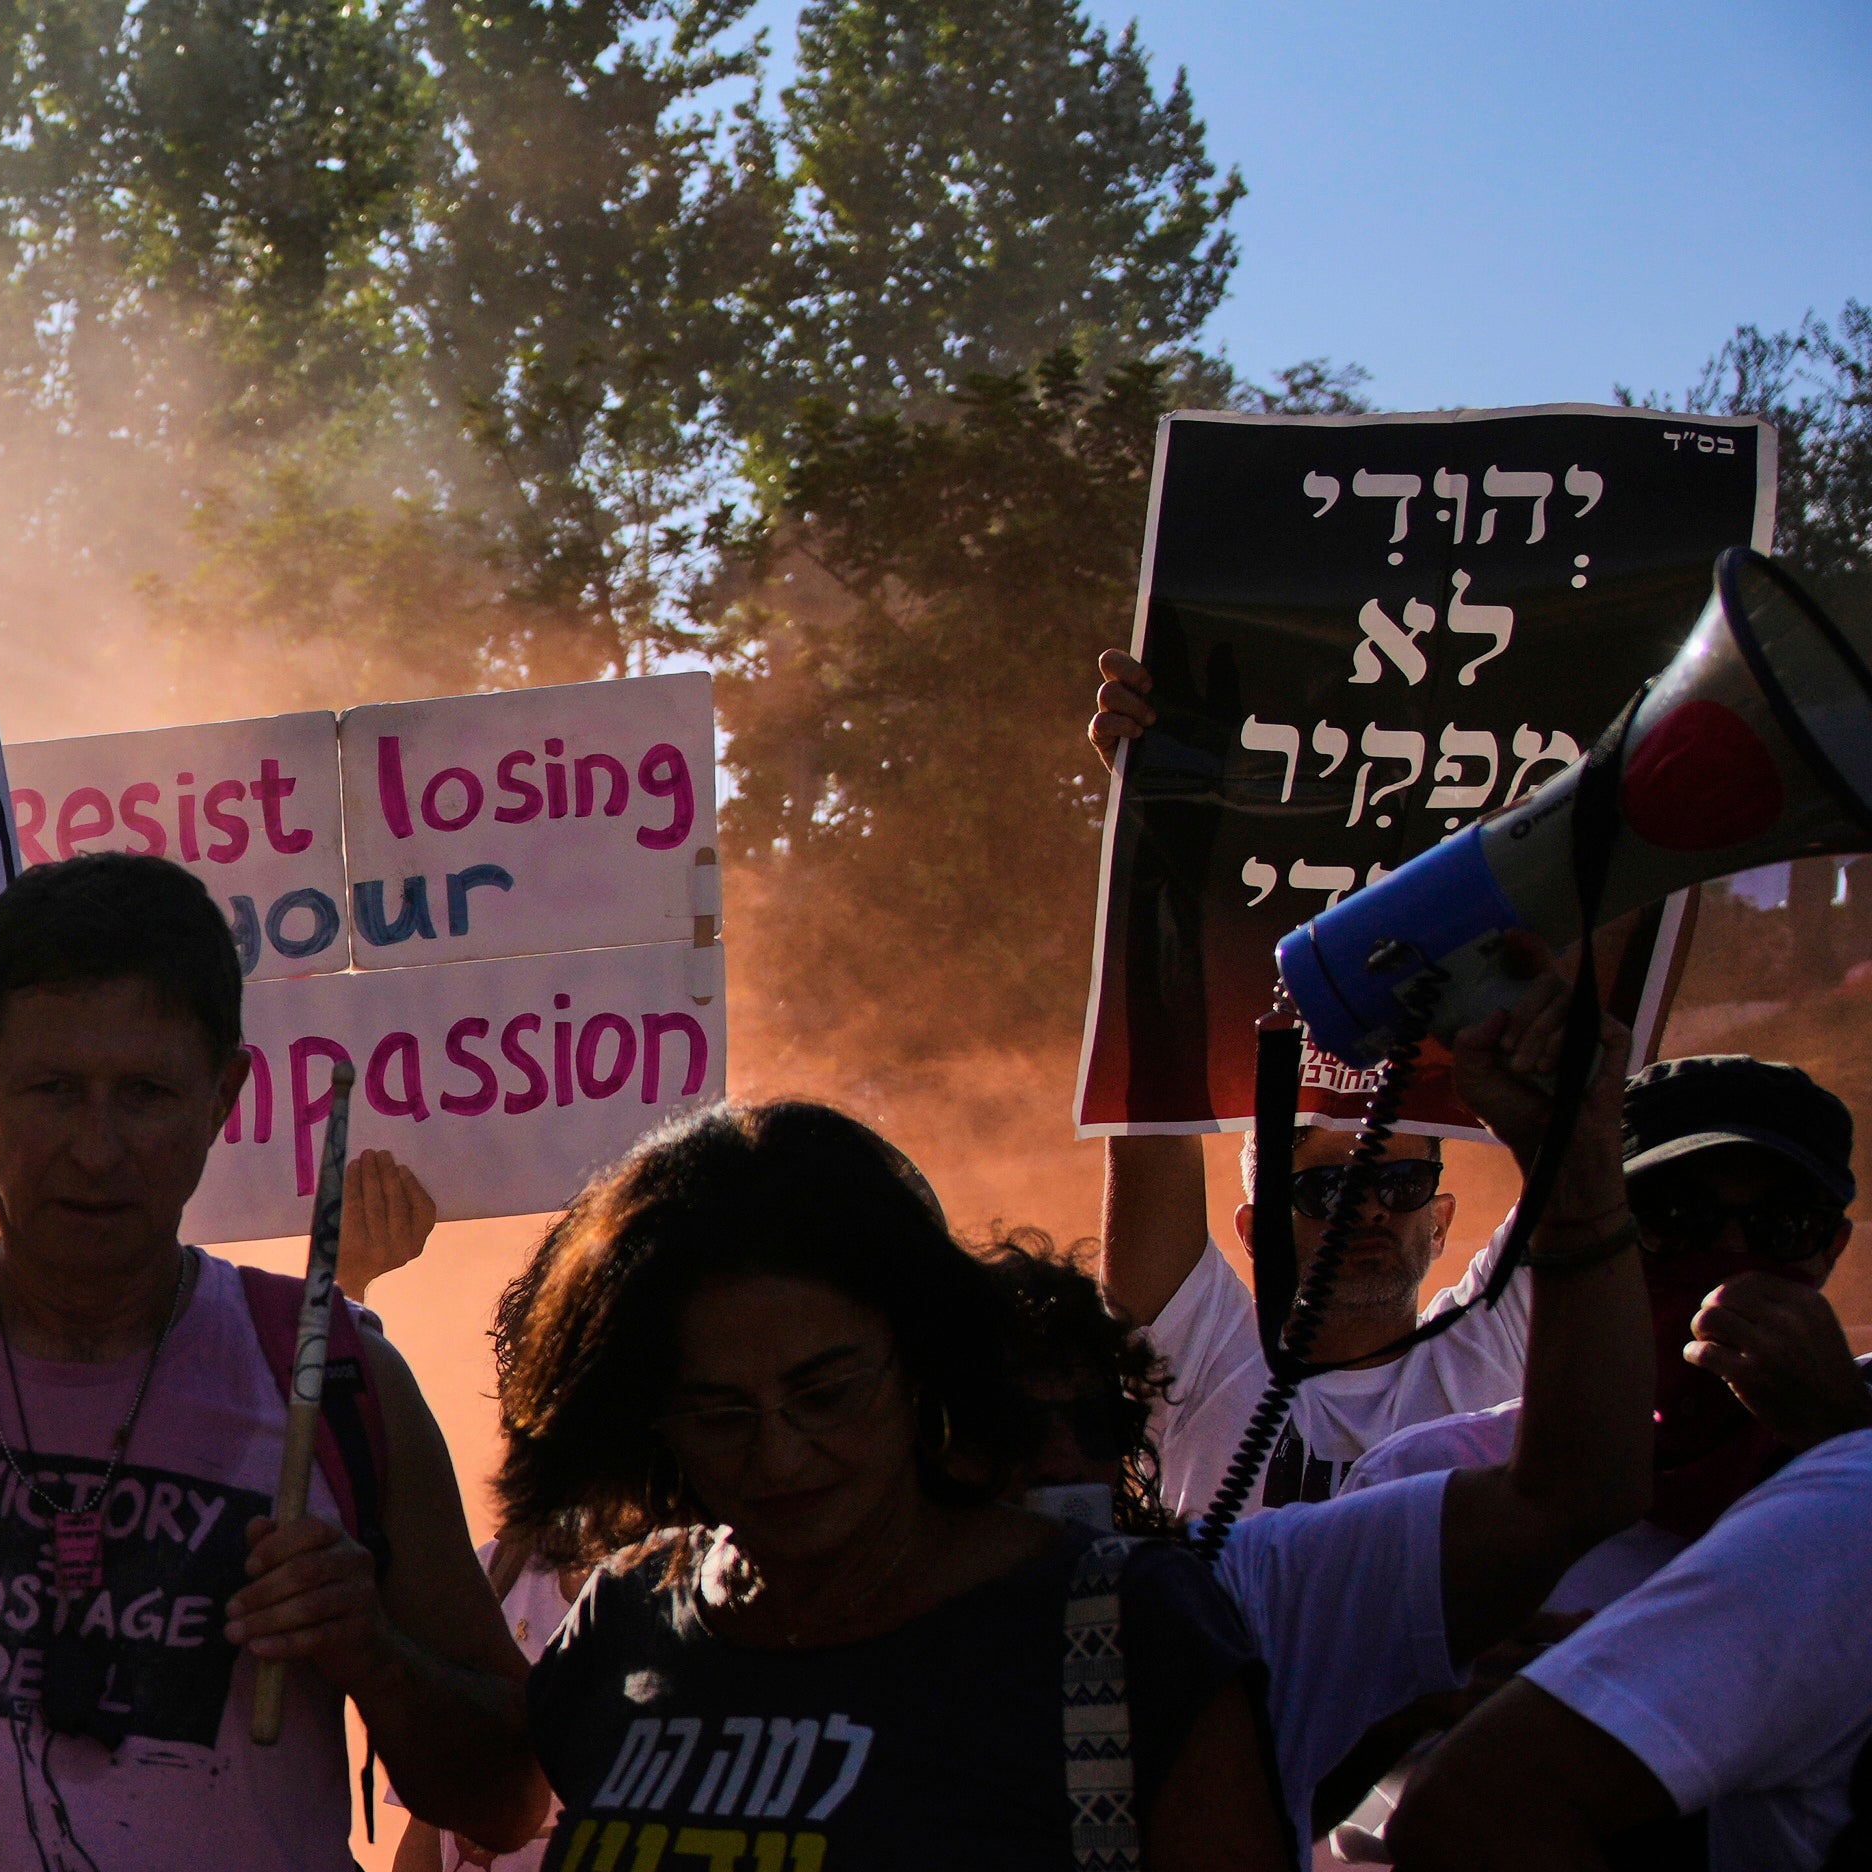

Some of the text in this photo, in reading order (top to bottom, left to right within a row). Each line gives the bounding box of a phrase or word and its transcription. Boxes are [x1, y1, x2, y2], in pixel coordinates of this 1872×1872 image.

[1346, 568, 1516, 688] לא
[377, 735, 696, 850] losing
[590, 1712, 876, 1822] למה הם
